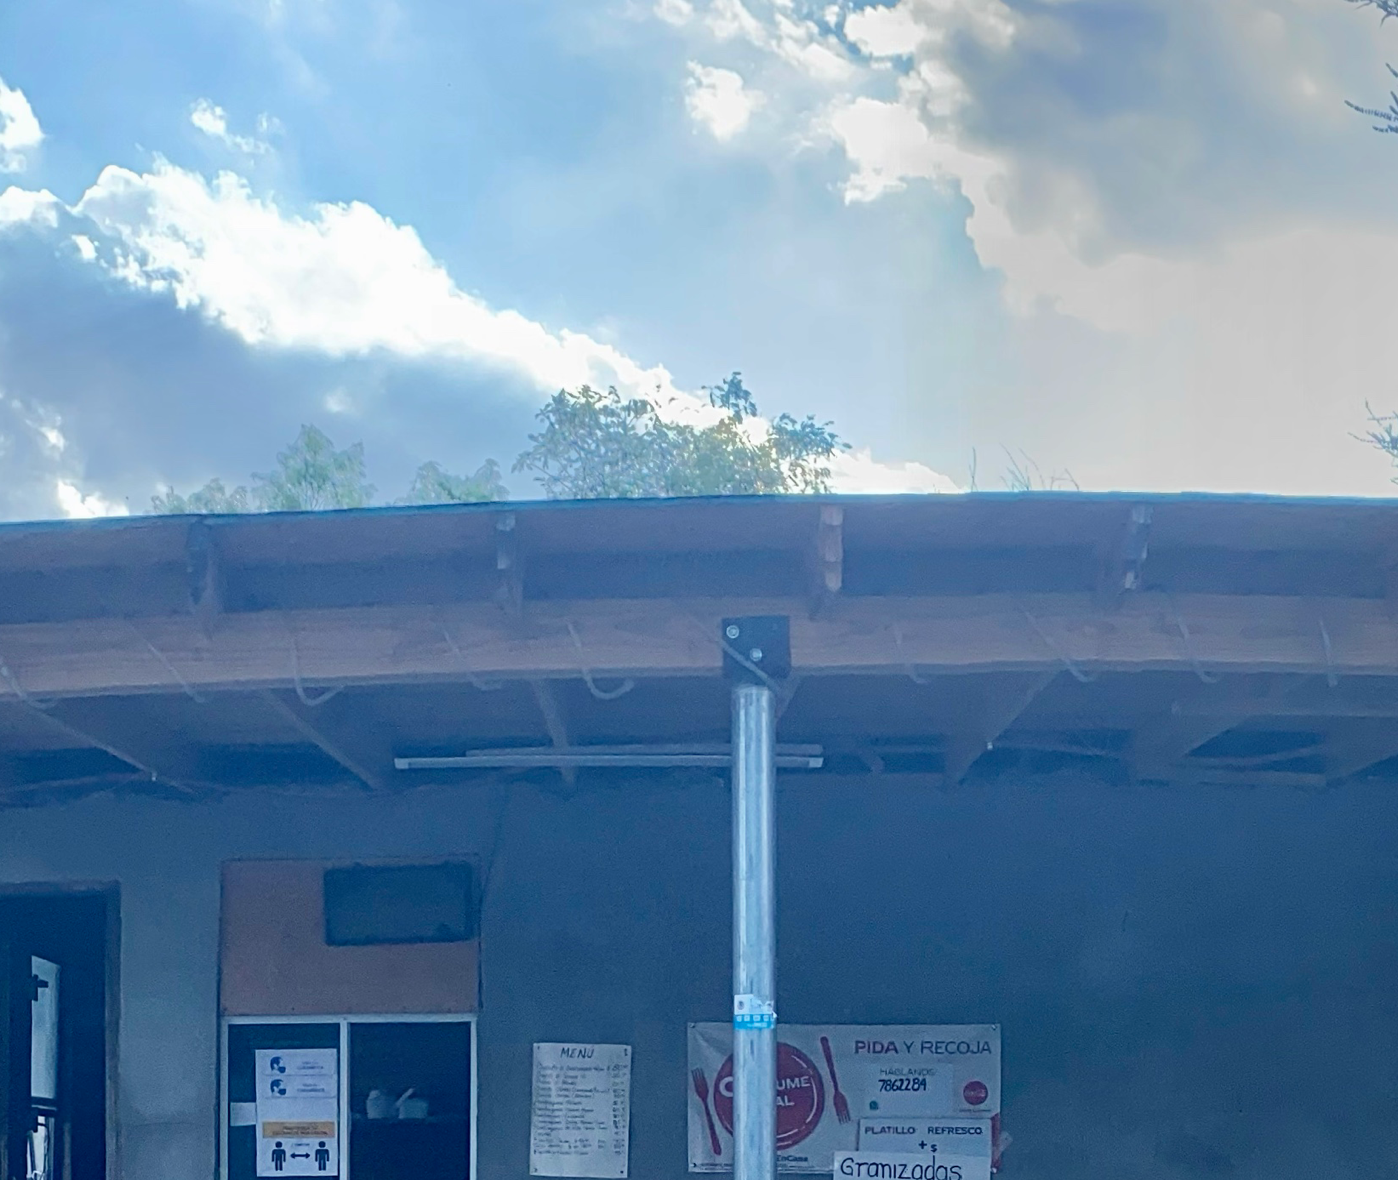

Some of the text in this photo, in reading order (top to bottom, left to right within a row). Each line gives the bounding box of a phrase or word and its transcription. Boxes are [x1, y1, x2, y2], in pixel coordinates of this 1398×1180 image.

[854, 1040, 992, 1054] PIDA Y RECOJA
[878, 1077, 927, 1093] 7862284
[864, 1125, 983, 1136] PLATILLO REFRESCO
